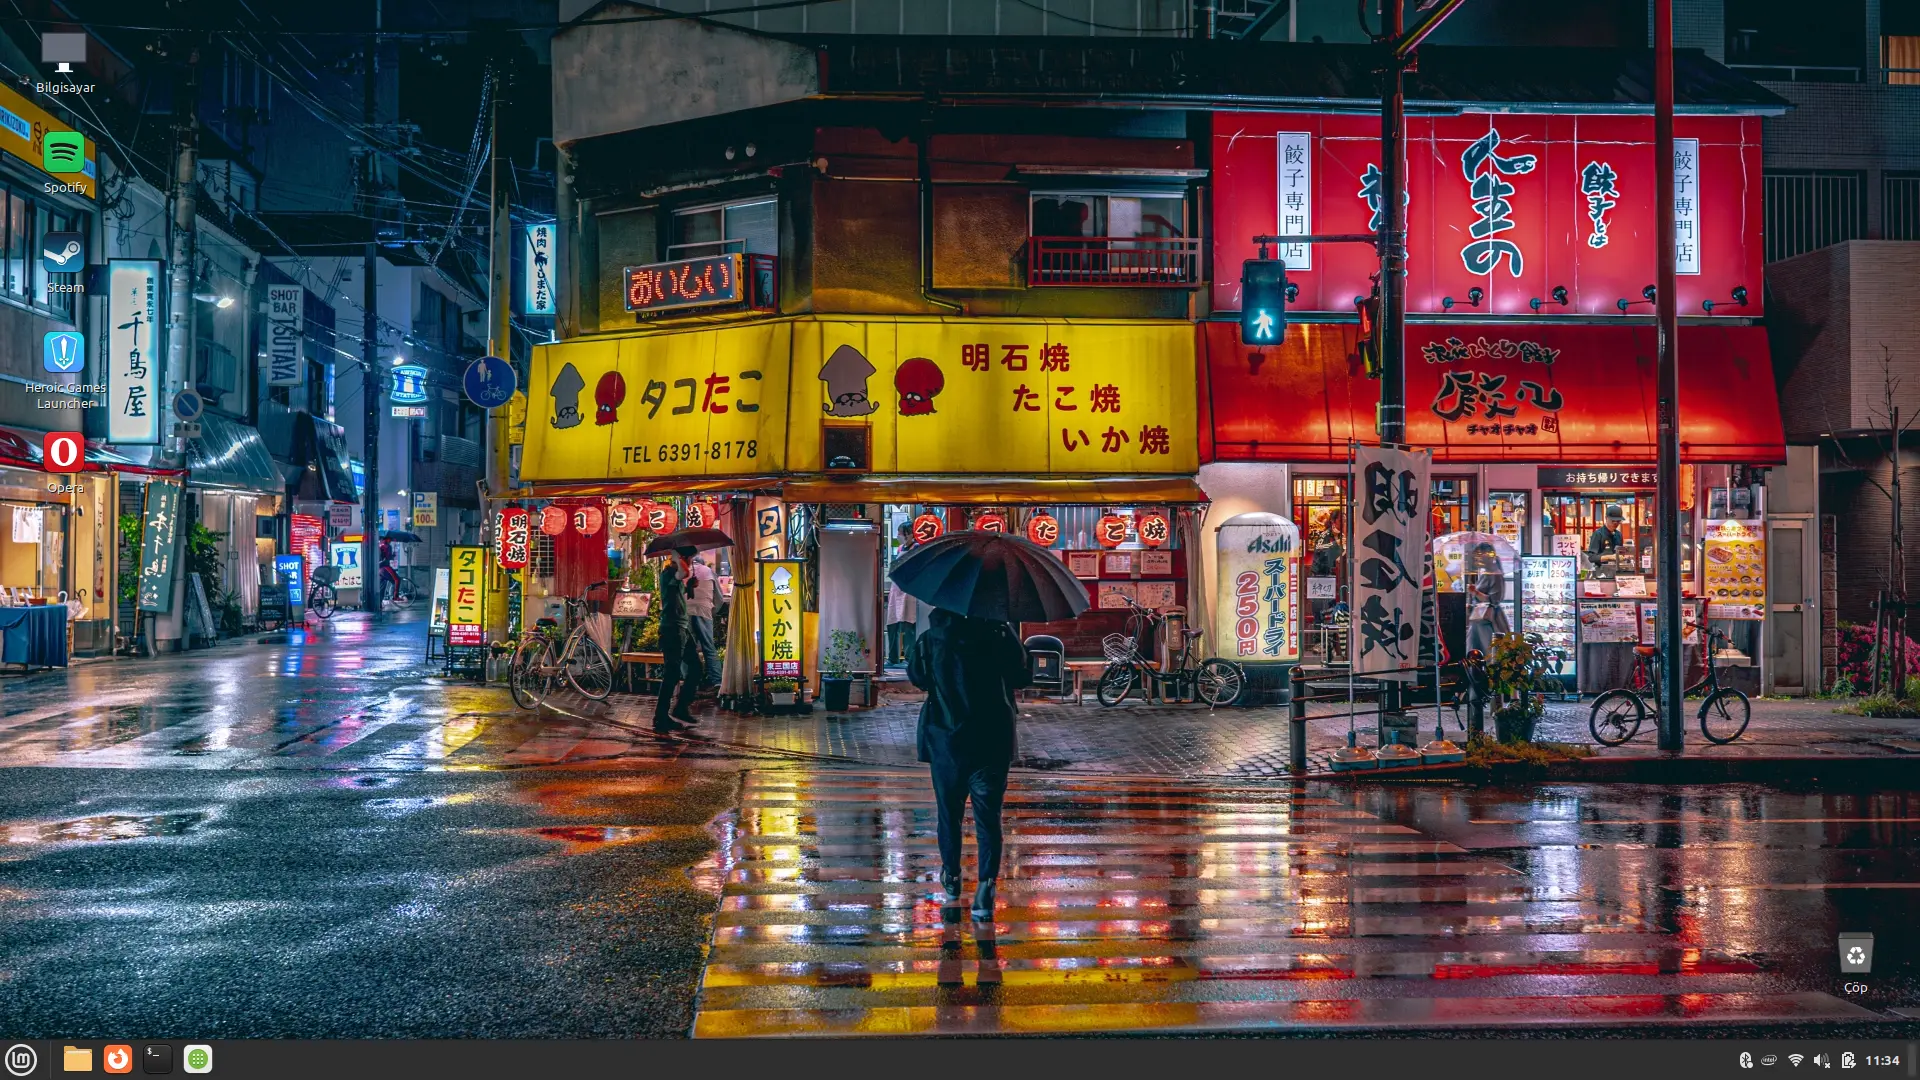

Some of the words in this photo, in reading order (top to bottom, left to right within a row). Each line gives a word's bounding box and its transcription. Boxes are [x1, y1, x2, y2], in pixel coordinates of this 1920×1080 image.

[1284, 144, 1305, 258] 餃子専門店
[1673, 150, 1693, 263] 餃子専門店
[536, 227, 547, 248] 焼肉
[270, 289, 299, 301] SHOT
[630, 262, 730, 305] おいしい
[273, 301, 297, 314] BAR
[117, 310, 148, 417] 千鳥屋
[271, 316, 297, 382] TSUTAYA
[961, 342, 1071, 372] 明石焼
[640, 369, 763, 420] タコたこ
[1012, 382, 1121, 414] たこ焼
[1061, 424, 1170, 456] いか焼
[1466, 422, 1539, 436] チャオチャオ
[622, 445, 652, 465] TEL
[658, 438, 758, 463] 6391-8178
[611, 510, 627, 528] た
[916, 521, 938, 541] タ
[1036, 521, 1057, 541] た
[1105, 522, 1125, 541] こ
[1143, 517, 1167, 541] 焼
[507, 514, 528, 564] 明石焼
[1247, 534, 1292, 554] Asahi
[279, 562, 300, 570] SHOT
[457, 550, 476, 623] タコたこ
[1235, 570, 1260, 657] 250円
[1262, 557, 1287, 657] スーパードライ
[772, 598, 793, 660] いか焼
[766, 662, 798, 670] 東三国店
